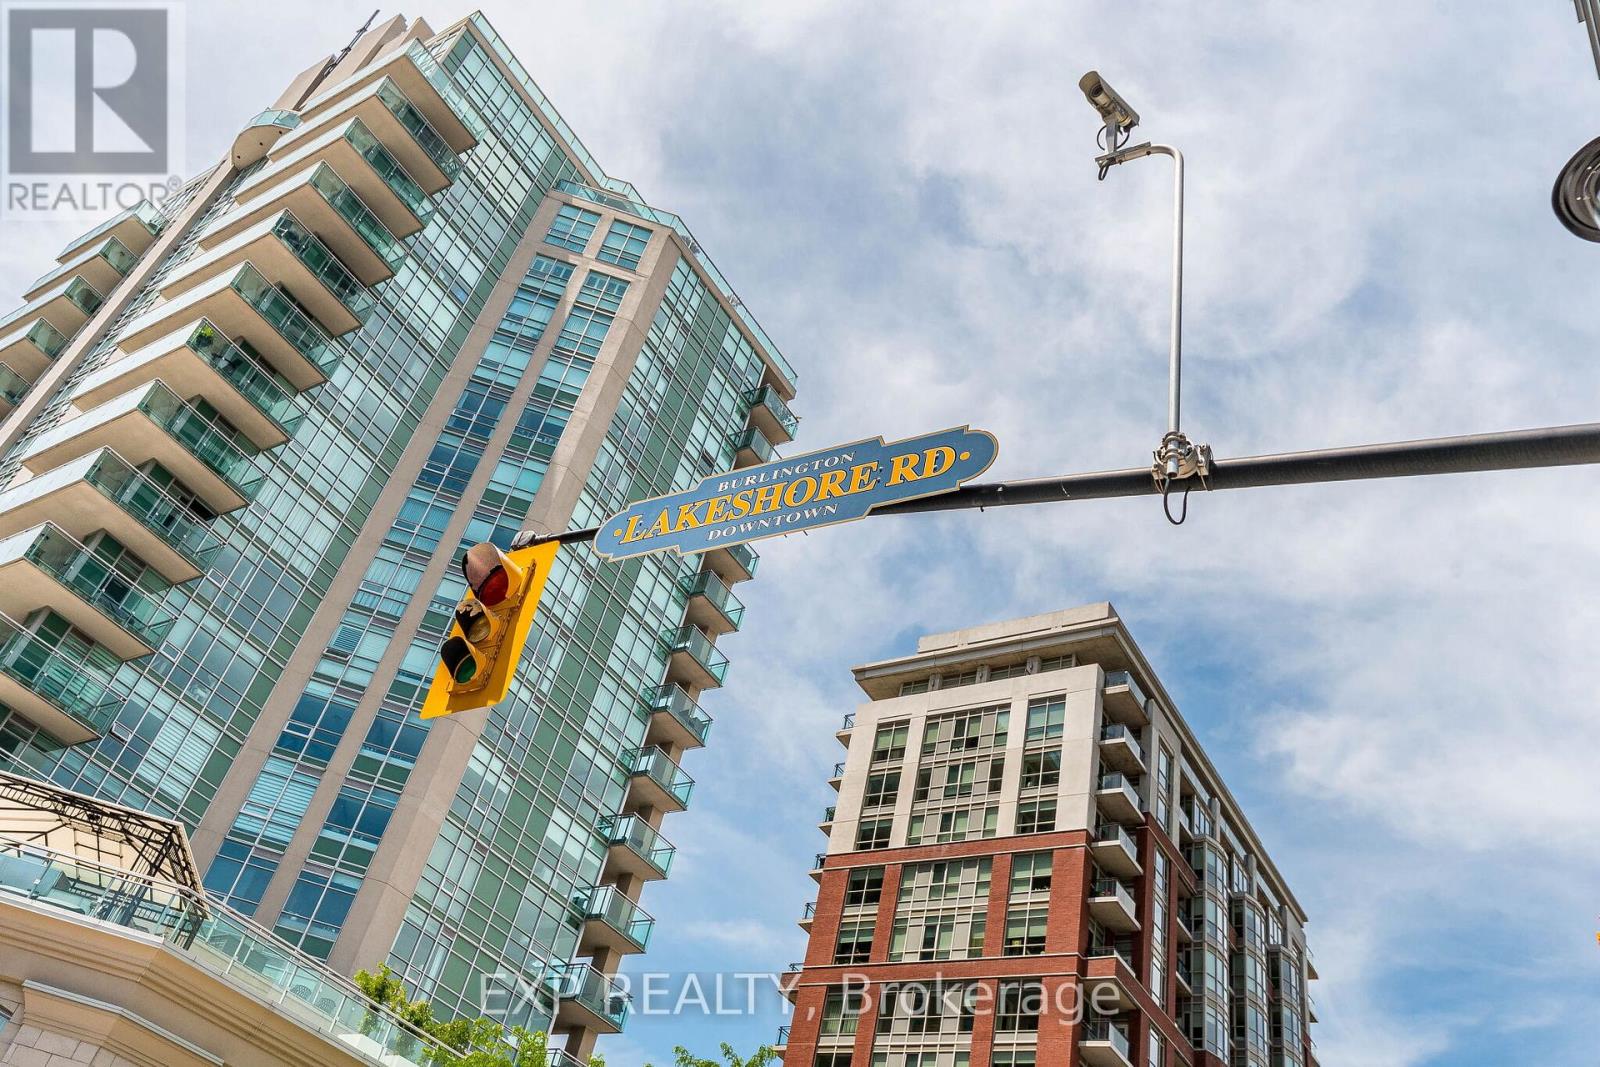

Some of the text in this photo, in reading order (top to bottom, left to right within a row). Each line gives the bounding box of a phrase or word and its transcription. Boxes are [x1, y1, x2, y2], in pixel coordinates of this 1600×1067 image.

[717, 451, 856, 493] BURLINGTON
[618, 446, 957, 545] LAKESHORE RD
[706, 503, 839, 541] DOWNTOWN
